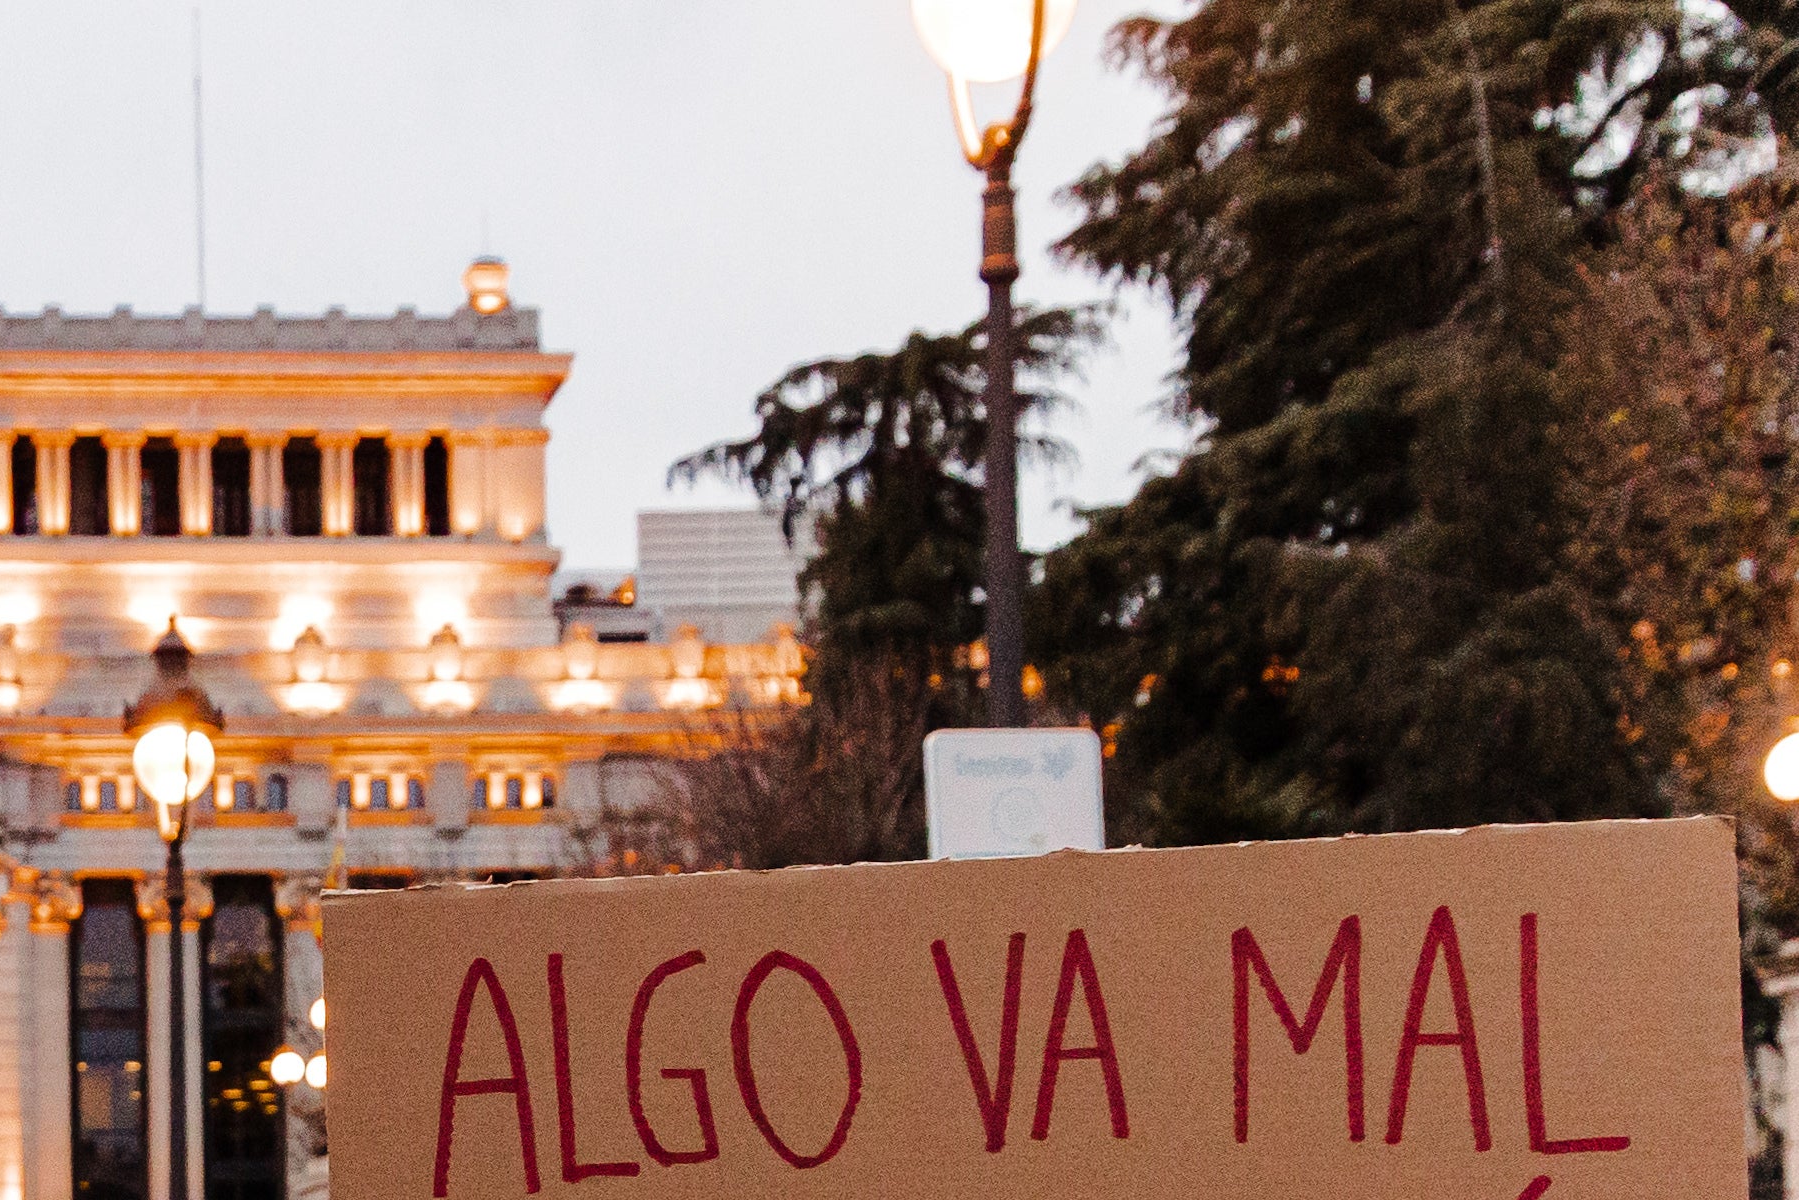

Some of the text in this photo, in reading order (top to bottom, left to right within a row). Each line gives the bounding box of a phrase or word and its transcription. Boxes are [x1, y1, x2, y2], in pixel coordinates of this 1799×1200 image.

[432, 904, 1631, 1198] ALGO VA MAL
